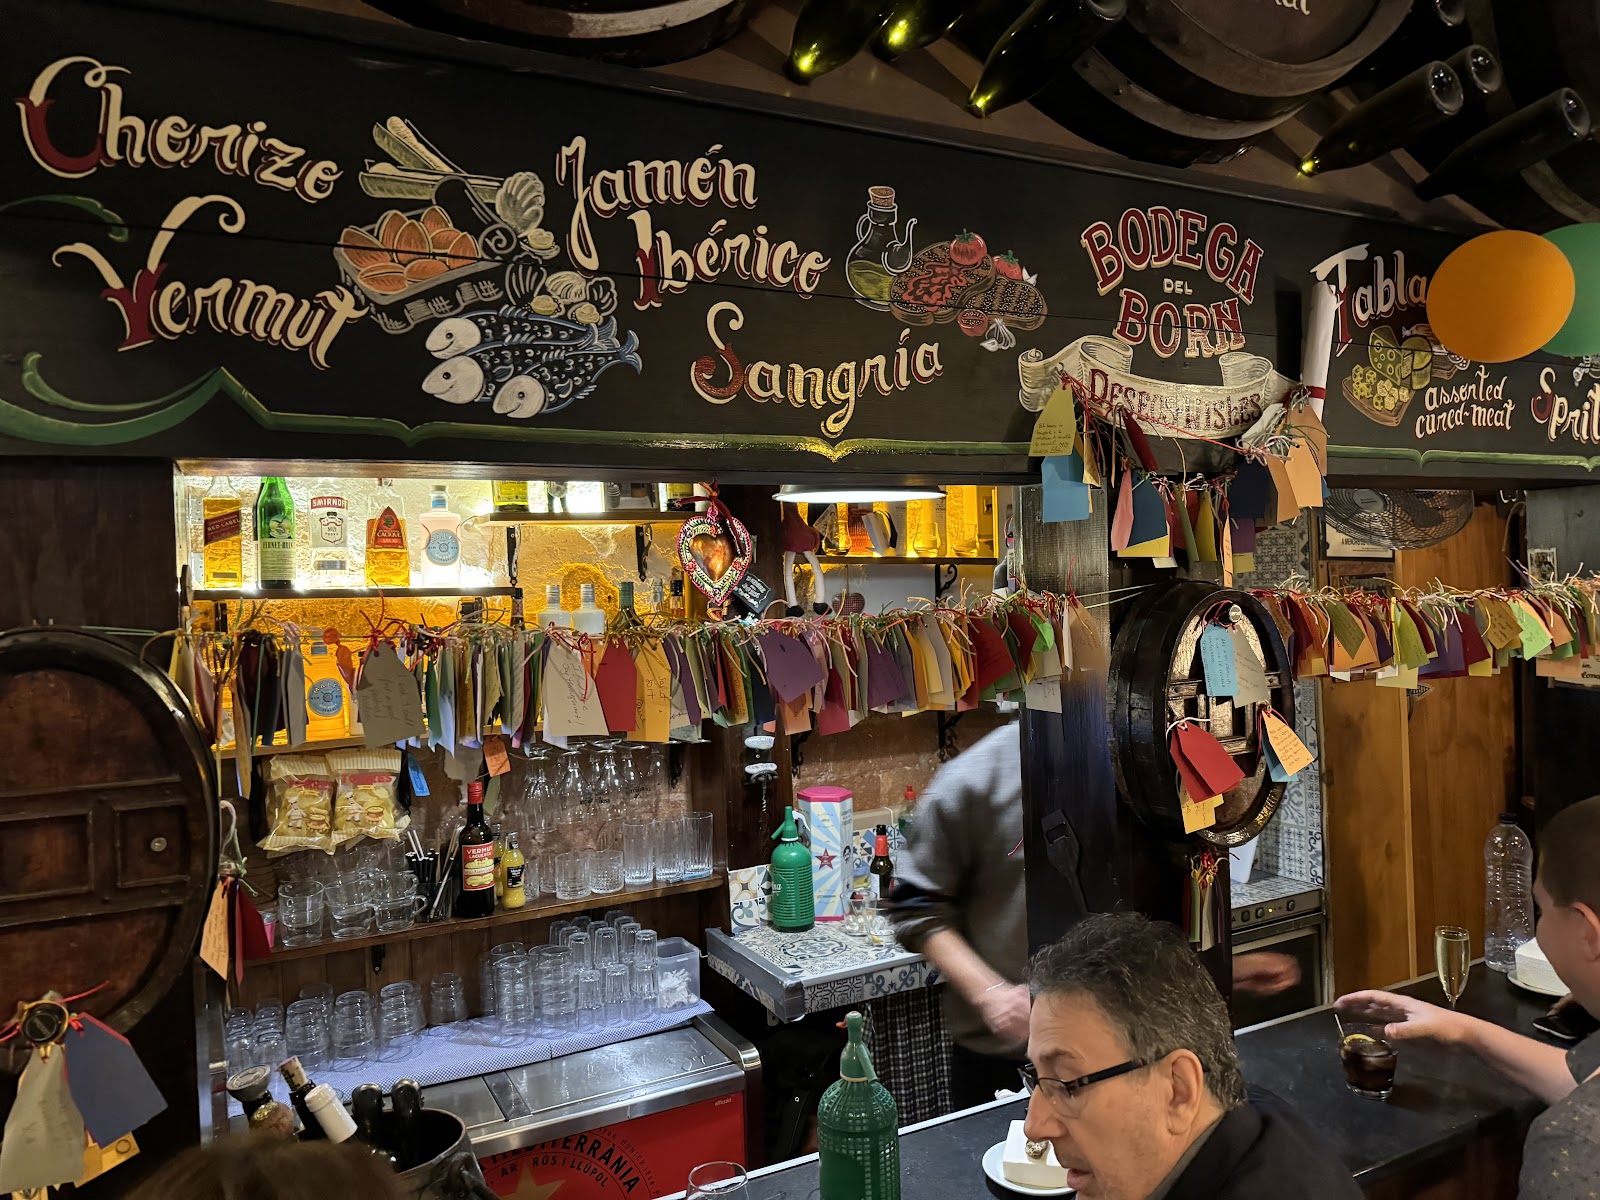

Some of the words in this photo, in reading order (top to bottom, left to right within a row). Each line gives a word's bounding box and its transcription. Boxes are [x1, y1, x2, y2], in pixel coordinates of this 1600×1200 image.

[16, 56, 343, 202] Chorizo
[556, 136, 758, 276] Jamón
[1080, 206, 1265, 305] BODEGA
[52, 195, 370, 369] Vermut
[628, 211, 831, 310] Ibérico
[1163, 278, 1193, 295] DEL
[691, 301, 943, 438] Sangría
[1112, 288, 1246, 359] BORN
[1424, 365, 1509, 411] assorted
[207, 523, 220, 532] RED
[220, 518, 241, 528] LABEL
